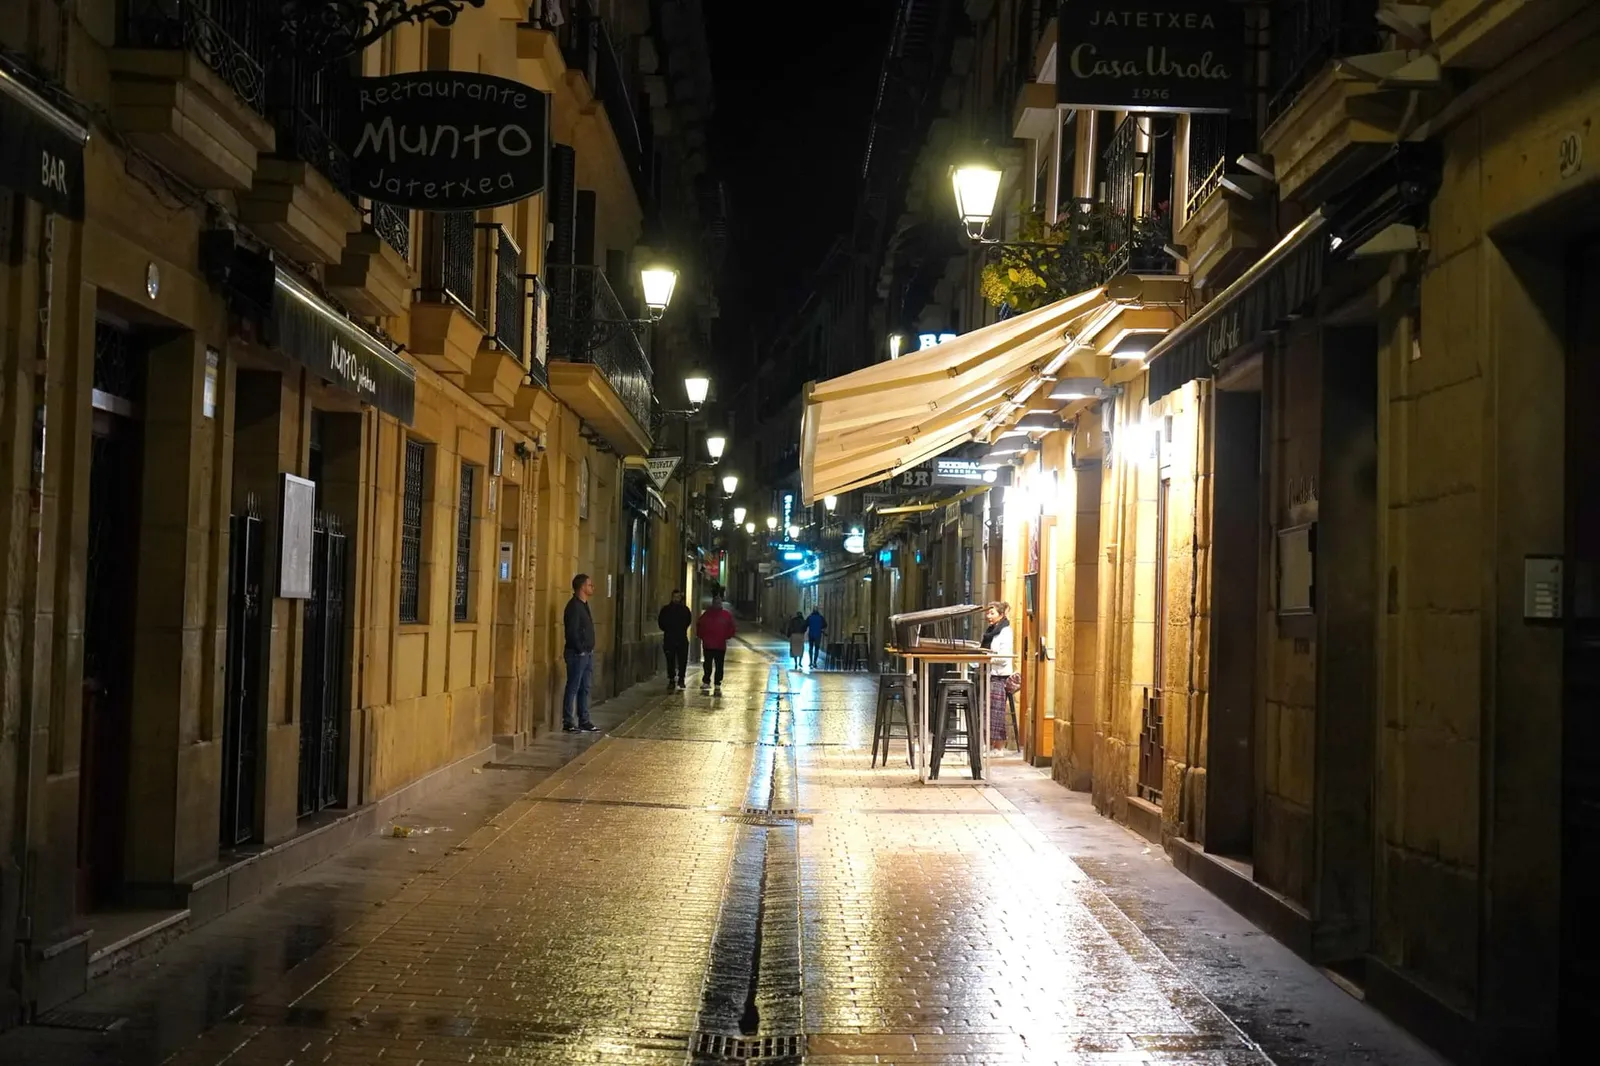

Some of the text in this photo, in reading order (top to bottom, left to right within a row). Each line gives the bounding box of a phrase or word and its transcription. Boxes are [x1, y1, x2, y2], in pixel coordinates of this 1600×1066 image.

[1089, 10, 1215, 29] JATETXEA
[1070, 42, 1232, 79] Casa Urola
[360, 79, 527, 112] Restaurante
[1131, 88, 1170, 99] 1956
[1559, 135, 1577, 173] 20
[41, 149, 68, 195] BAR
[369, 168, 515, 199] Jatetxea
